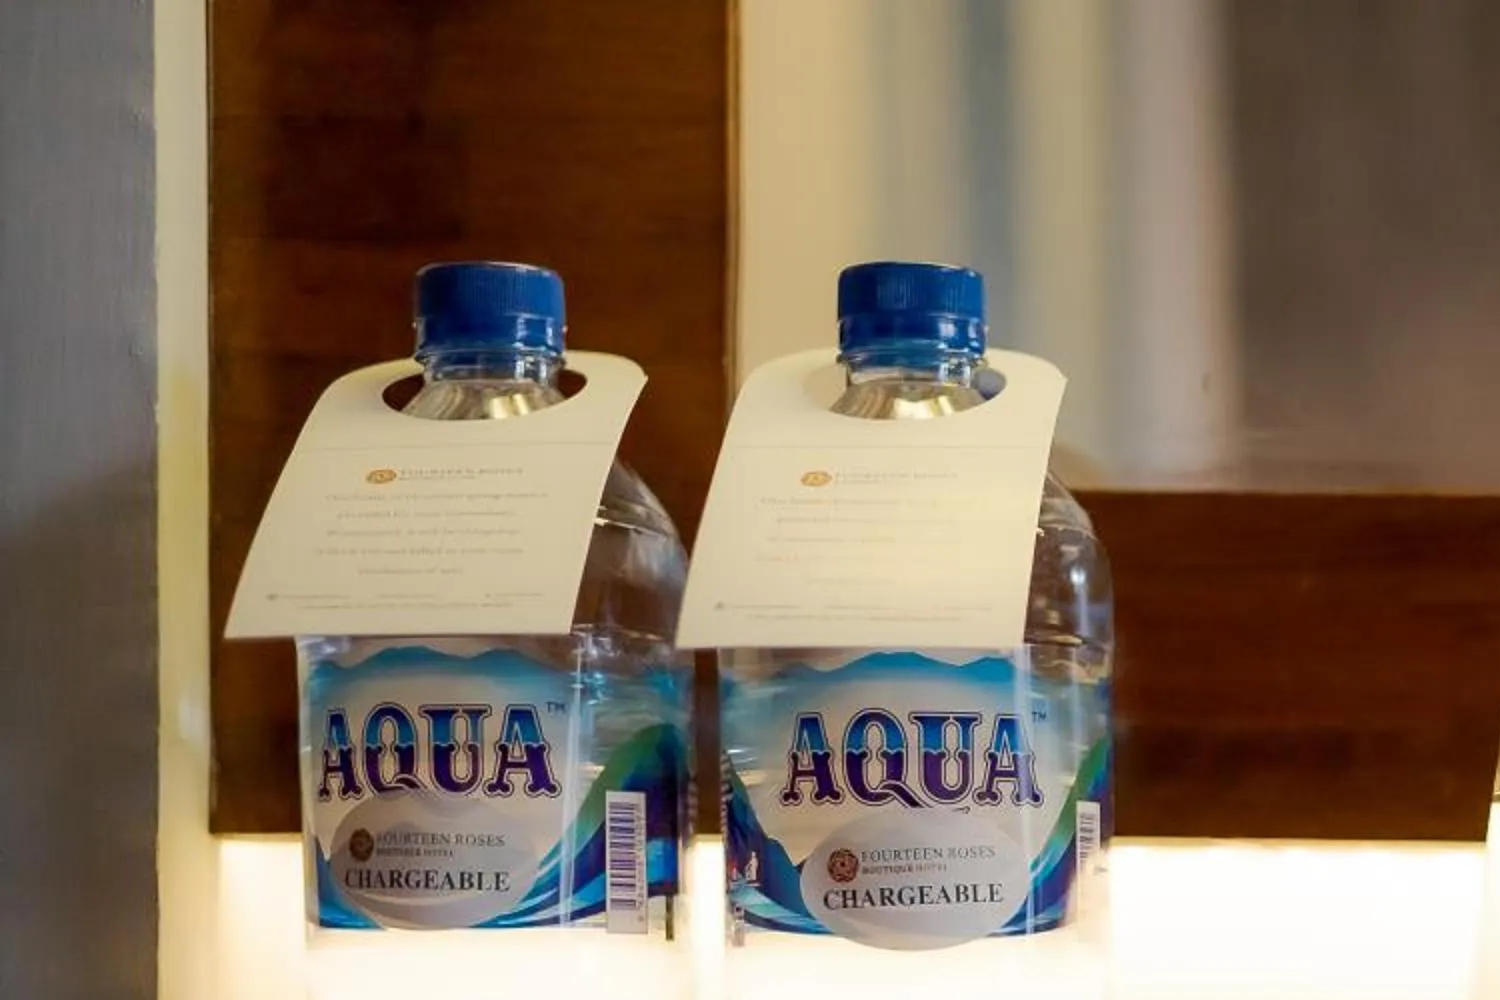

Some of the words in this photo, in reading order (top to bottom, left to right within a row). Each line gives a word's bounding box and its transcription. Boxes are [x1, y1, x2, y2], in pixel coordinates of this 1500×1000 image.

[318, 701, 562, 800] AQUA
[779, 707, 1044, 809] AQUA
[455, 833, 505, 847] ROSES
[861, 848, 944, 863] FOURTEEN
[947, 845, 996, 860] ROSES
[344, 868, 511, 892] CHARGEABLE
[823, 883, 1004, 911] CHARGEABLE
